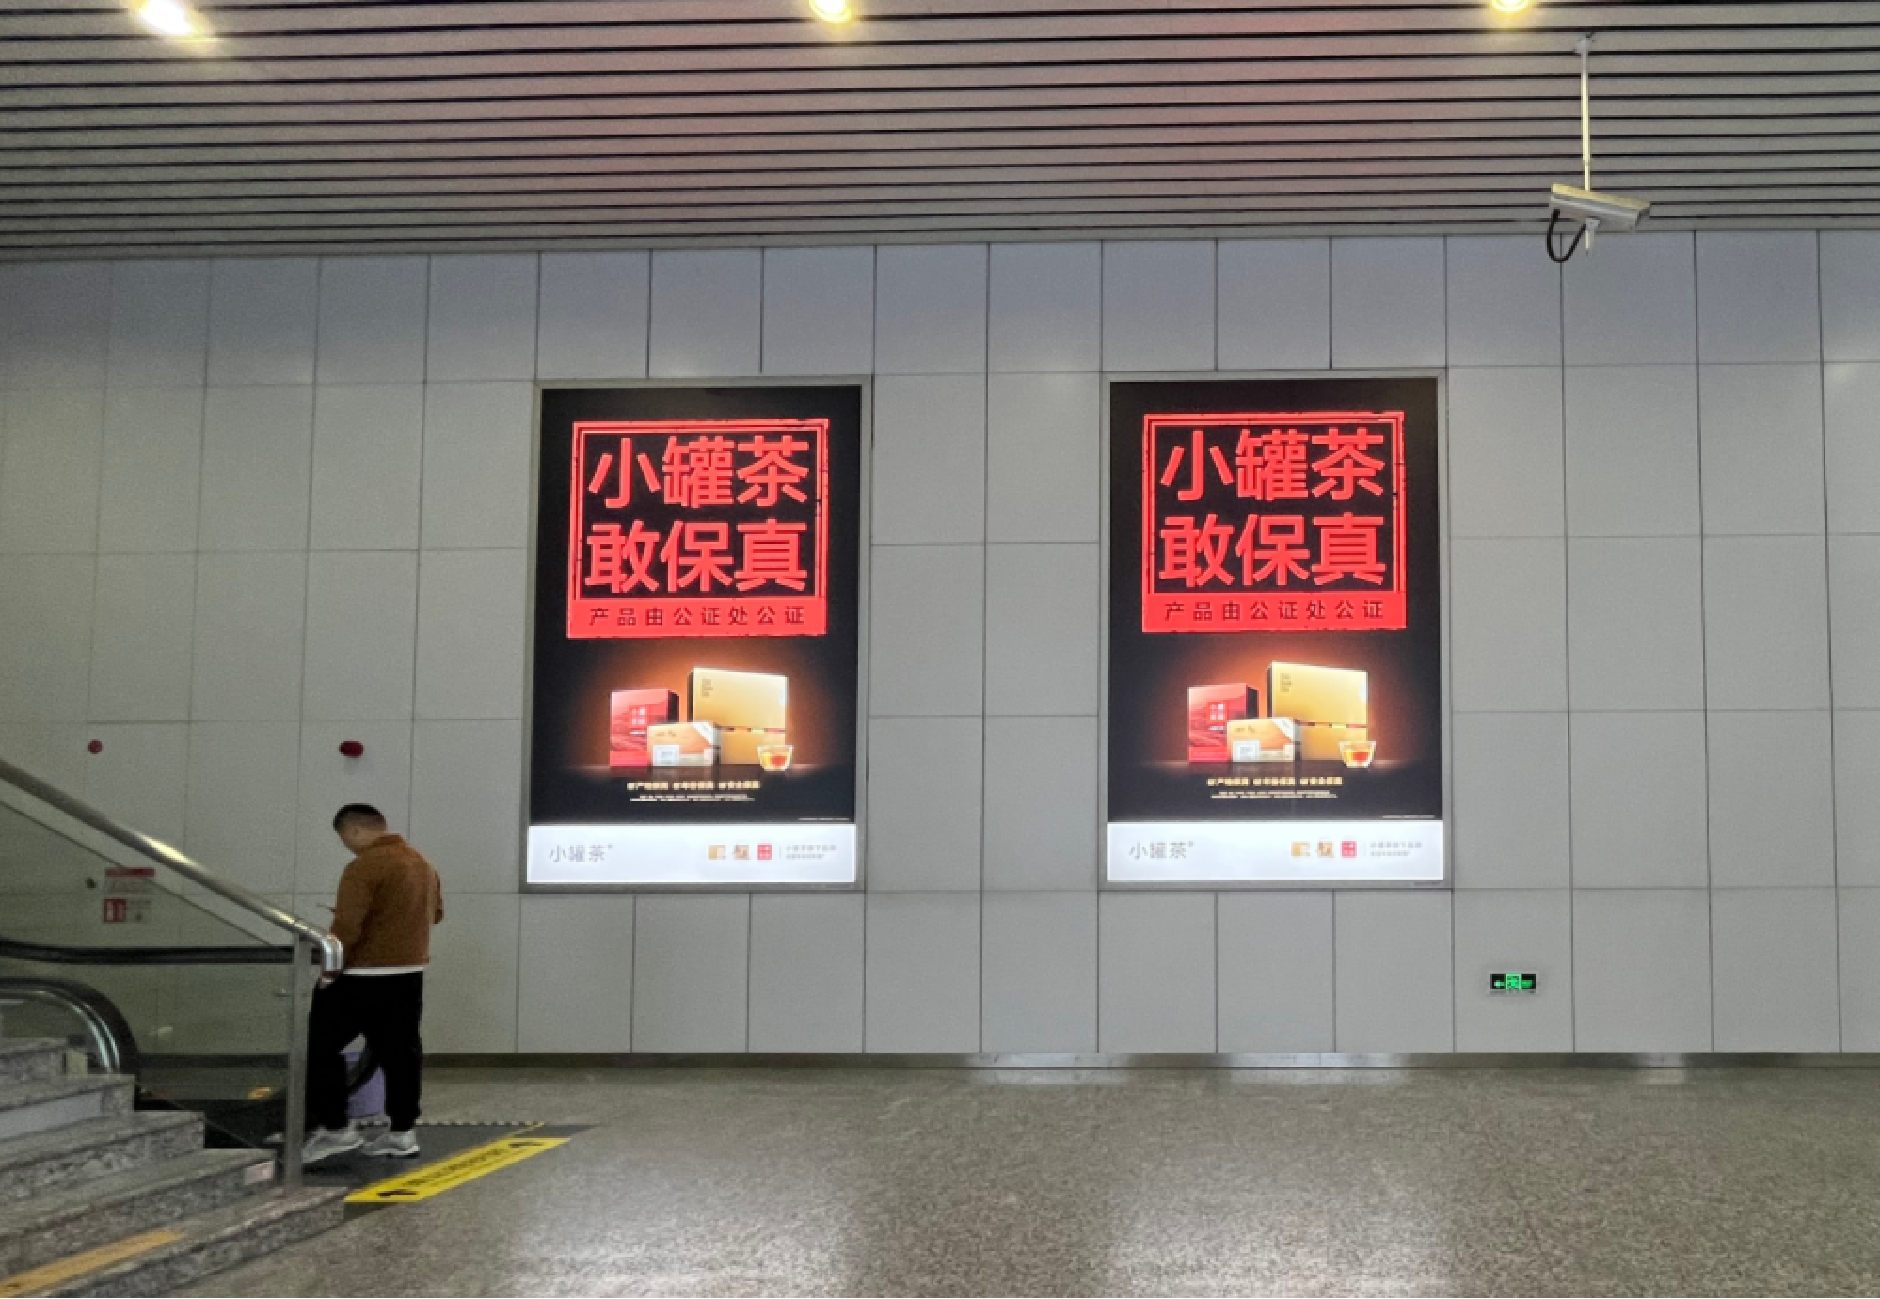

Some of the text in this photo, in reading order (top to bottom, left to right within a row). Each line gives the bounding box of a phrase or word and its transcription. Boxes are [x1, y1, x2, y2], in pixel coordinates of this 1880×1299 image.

[588, 434, 810, 509] 小罐茶
[1160, 427, 1386, 502] 小罐茶
[584, 518, 808, 594] 敢保真
[1158, 511, 1387, 588] 敢保真
[589, 606, 806, 627] 产品由公证处公证
[1164, 600, 1385, 622] 产品由公证处公证
